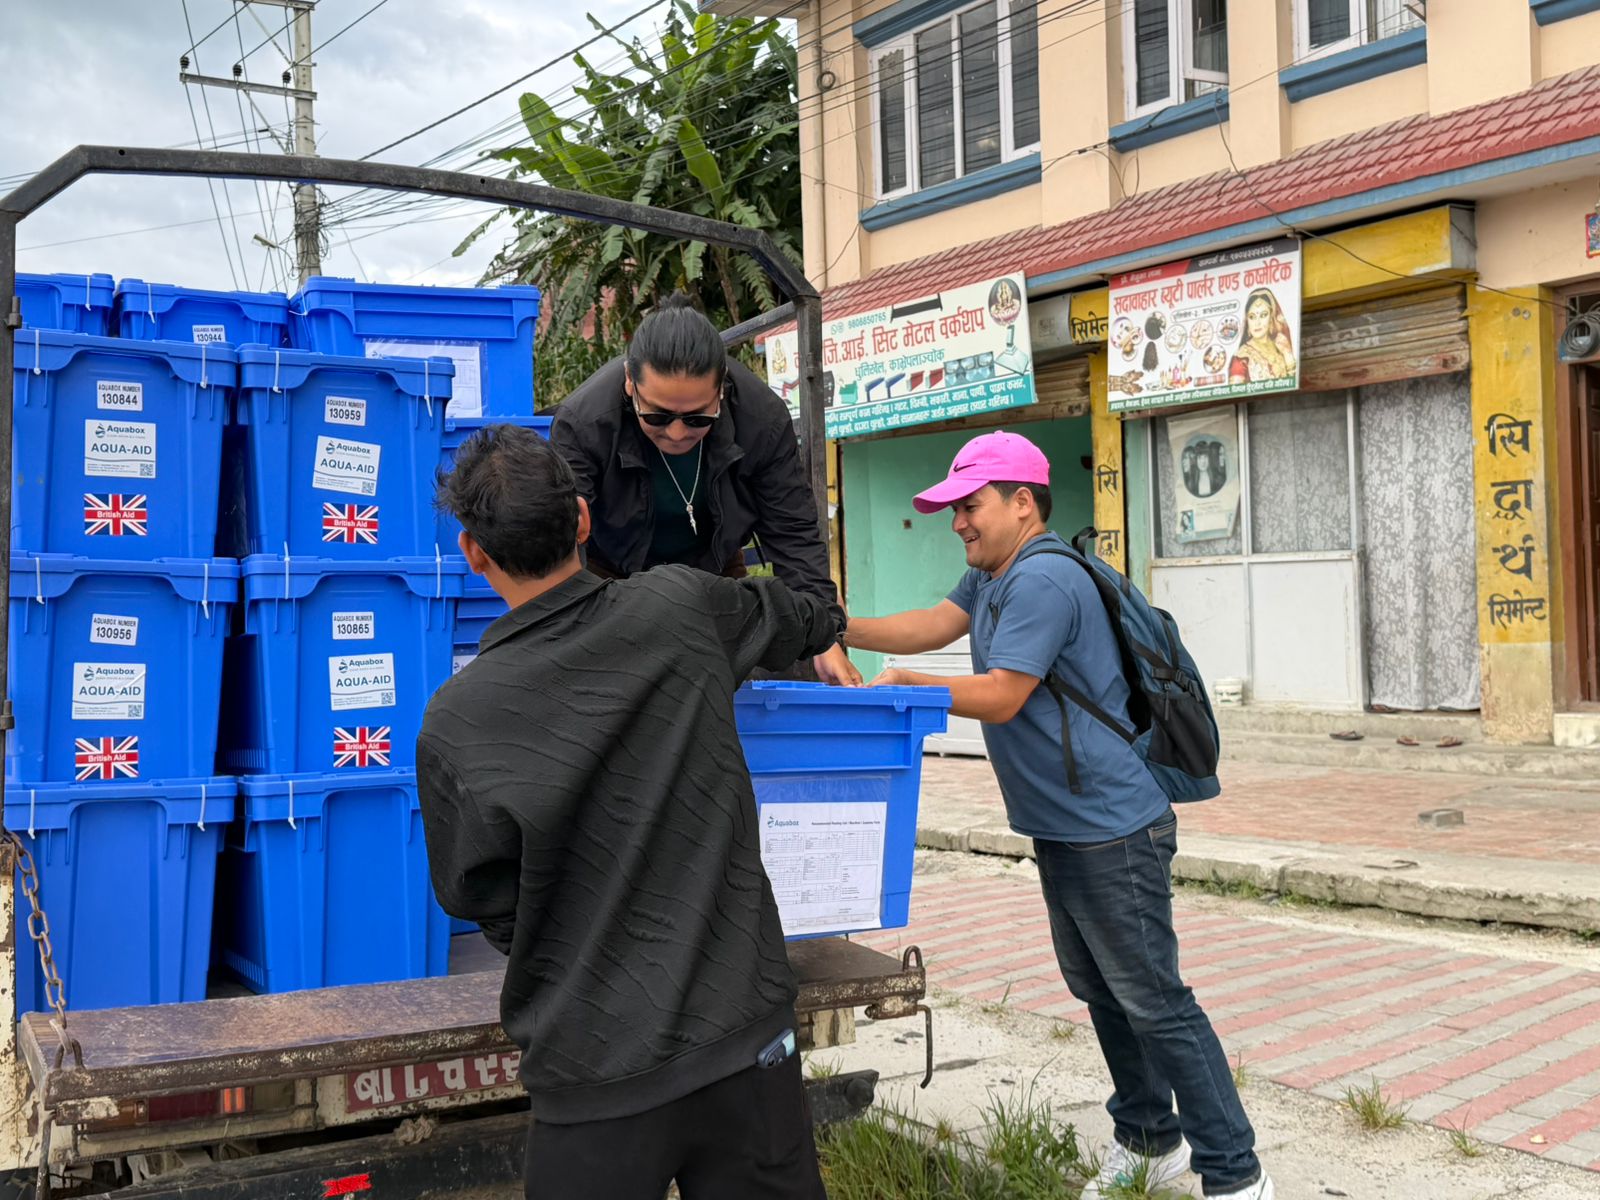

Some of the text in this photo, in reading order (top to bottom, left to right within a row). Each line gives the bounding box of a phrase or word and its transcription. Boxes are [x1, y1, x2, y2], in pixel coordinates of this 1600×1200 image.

[1187, 272, 1215, 300] पार्लर
[1218, 271, 1241, 295] एण्ड
[872, 325, 898, 355] सिट
[902, 319, 936, 350] मेटल
[939, 305, 986, 339] वर्कशप
[1071, 311, 1108, 340] सिमेन्
[197, 333, 222, 342] 130944
[122, 385, 141, 393] NUMBER
[102, 393, 138, 406] 130844
[329, 408, 361, 421] 130959
[106, 424, 146, 434] Aquabox
[91, 442, 152, 455] AQUA-AID
[336, 442, 371, 454] Aquabox
[320, 457, 375, 475] AQUA-AID
[97, 510, 135, 519] British Aid
[333, 519, 368, 528] British Aid
[1487, 589, 1546, 631] सिमेन्ट
[93, 617, 137, 627] AQUABOX NUMBER
[96, 627, 132, 640] 130956
[336, 623, 370, 635] 130865
[348, 658, 384, 668] Aquabox
[95, 667, 135, 677] Aquabox
[335, 674, 392, 688] AQUA-AID
[79, 685, 142, 697] AQUA-AID
[344, 742, 380, 751] British Aid
[88, 753, 126, 763] British Aid
[774, 818, 799, 828] Aquabox
